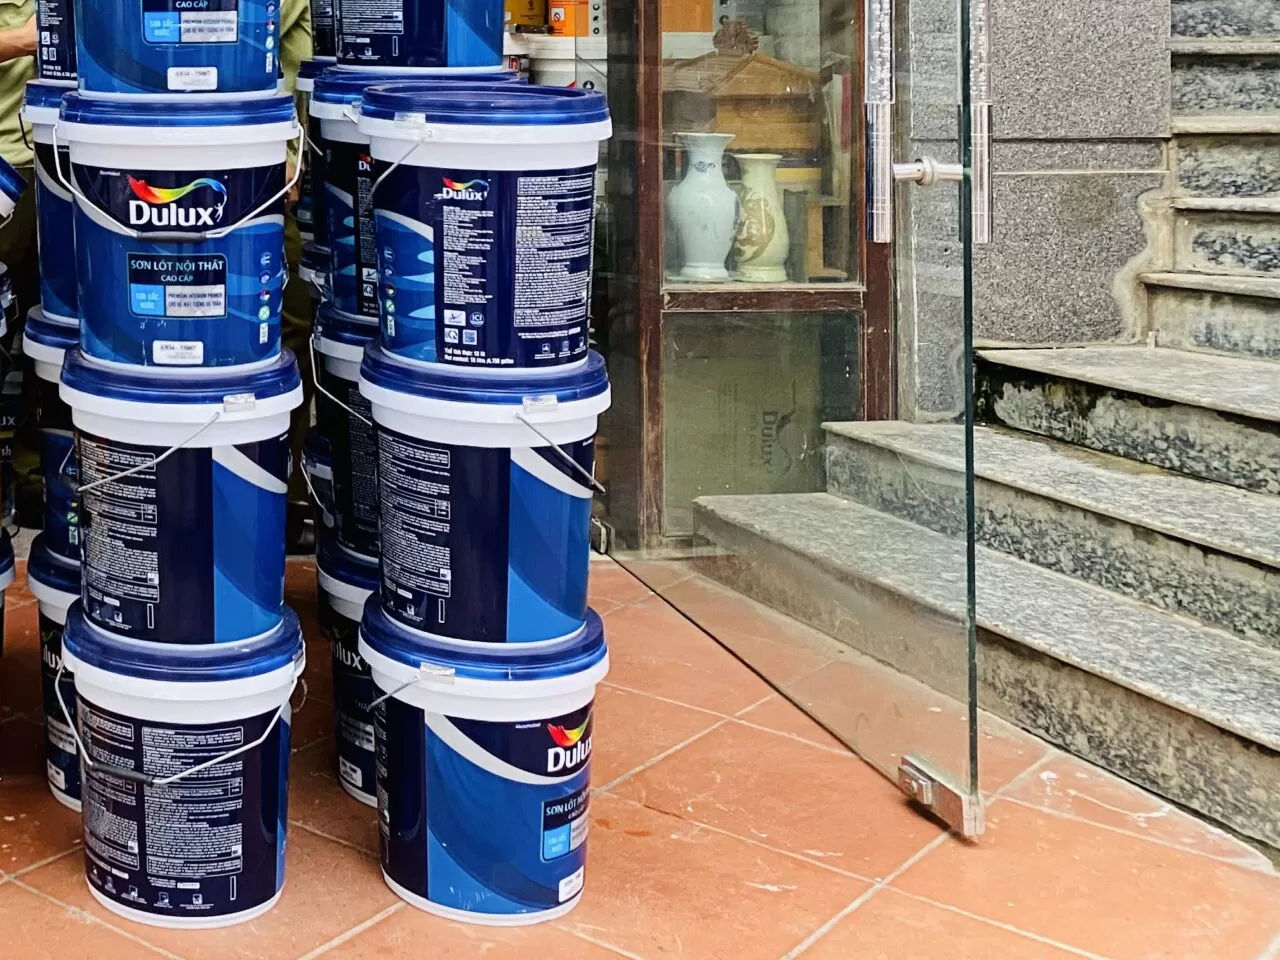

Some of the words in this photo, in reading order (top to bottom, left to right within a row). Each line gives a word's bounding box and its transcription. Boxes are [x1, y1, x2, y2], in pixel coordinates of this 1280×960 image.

[175, 0, 193, 9] CAO
[442, 187, 484, 201] Dulux
[129, 200, 215, 227] Dulux
[131, 259, 151, 270] SƠN
[153, 258, 173, 271] LÓT
[175, 259, 196, 273] NỘI
[198, 258, 224, 271] THẤT
[160, 274, 177, 282] CAO
[331, 640, 362, 671] ulux
